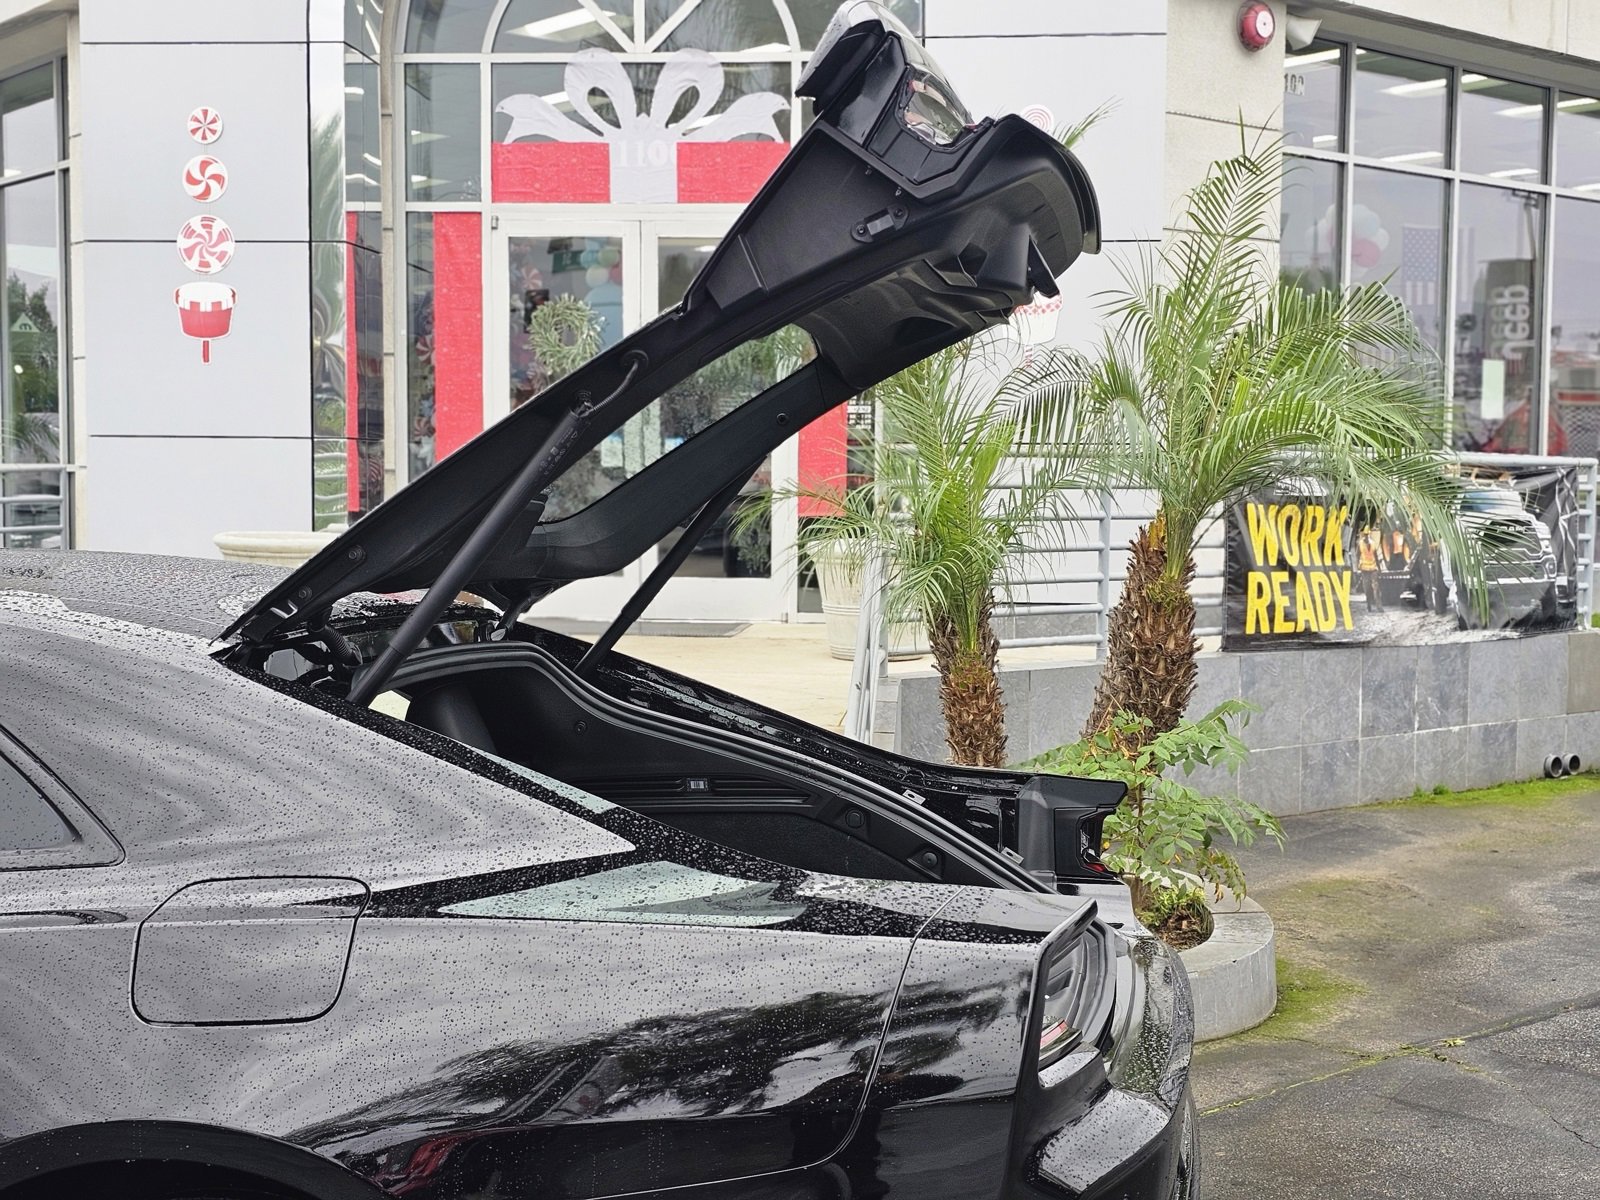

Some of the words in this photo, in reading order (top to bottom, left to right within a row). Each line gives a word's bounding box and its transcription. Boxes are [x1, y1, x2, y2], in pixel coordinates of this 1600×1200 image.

[617, 139, 676, 167] 110
[1247, 503, 1348, 566] WORK
[1246, 571, 1354, 634] READY
